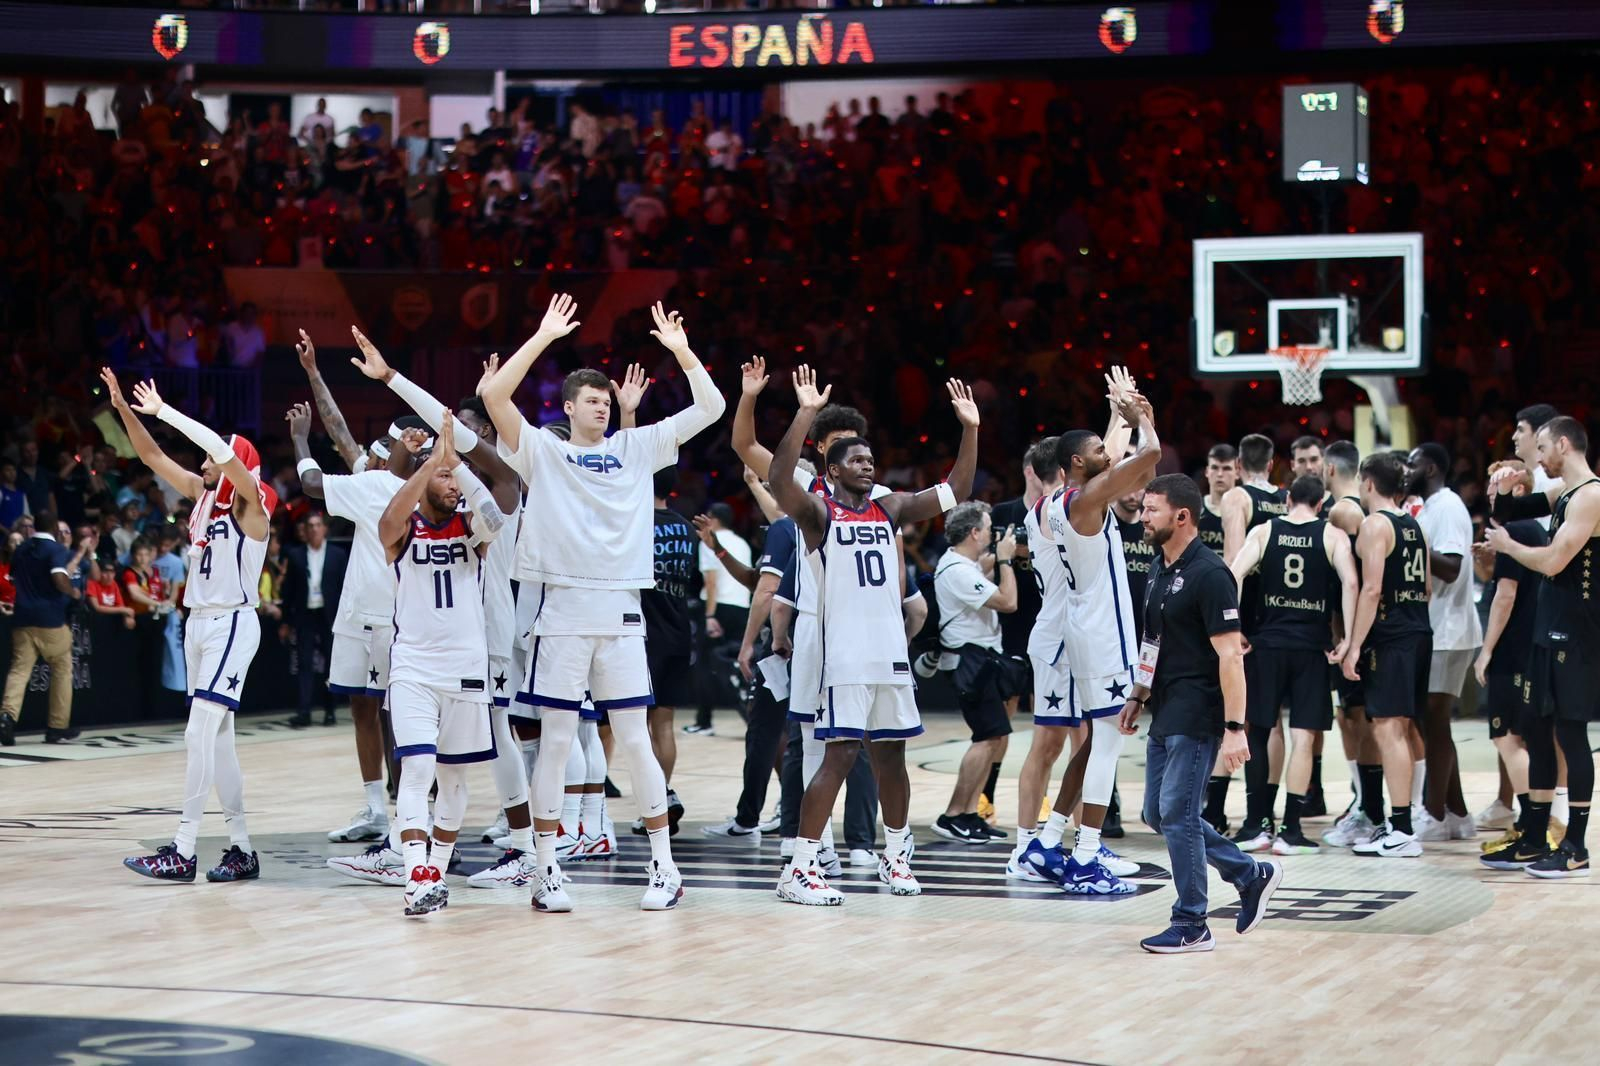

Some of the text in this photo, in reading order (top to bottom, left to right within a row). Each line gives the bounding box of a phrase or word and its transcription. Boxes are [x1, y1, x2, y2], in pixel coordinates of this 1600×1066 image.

[669, 13, 875, 68] ESPAÑA
[653, 523, 688, 538] ANTI
[836, 526, 890, 546] USA
[1277, 534, 1313, 549] BRIZUELA
[412, 542, 469, 566] USA
[653, 539, 694, 557] OCIAL
[1123, 539, 1156, 557] PAÑA
[200, 546, 213, 580] 4
[854, 550, 887, 587] 10
[1283, 553, 1305, 589] 8
[1402, 546, 1426, 583] 24
[433, 569, 454, 609] 11
